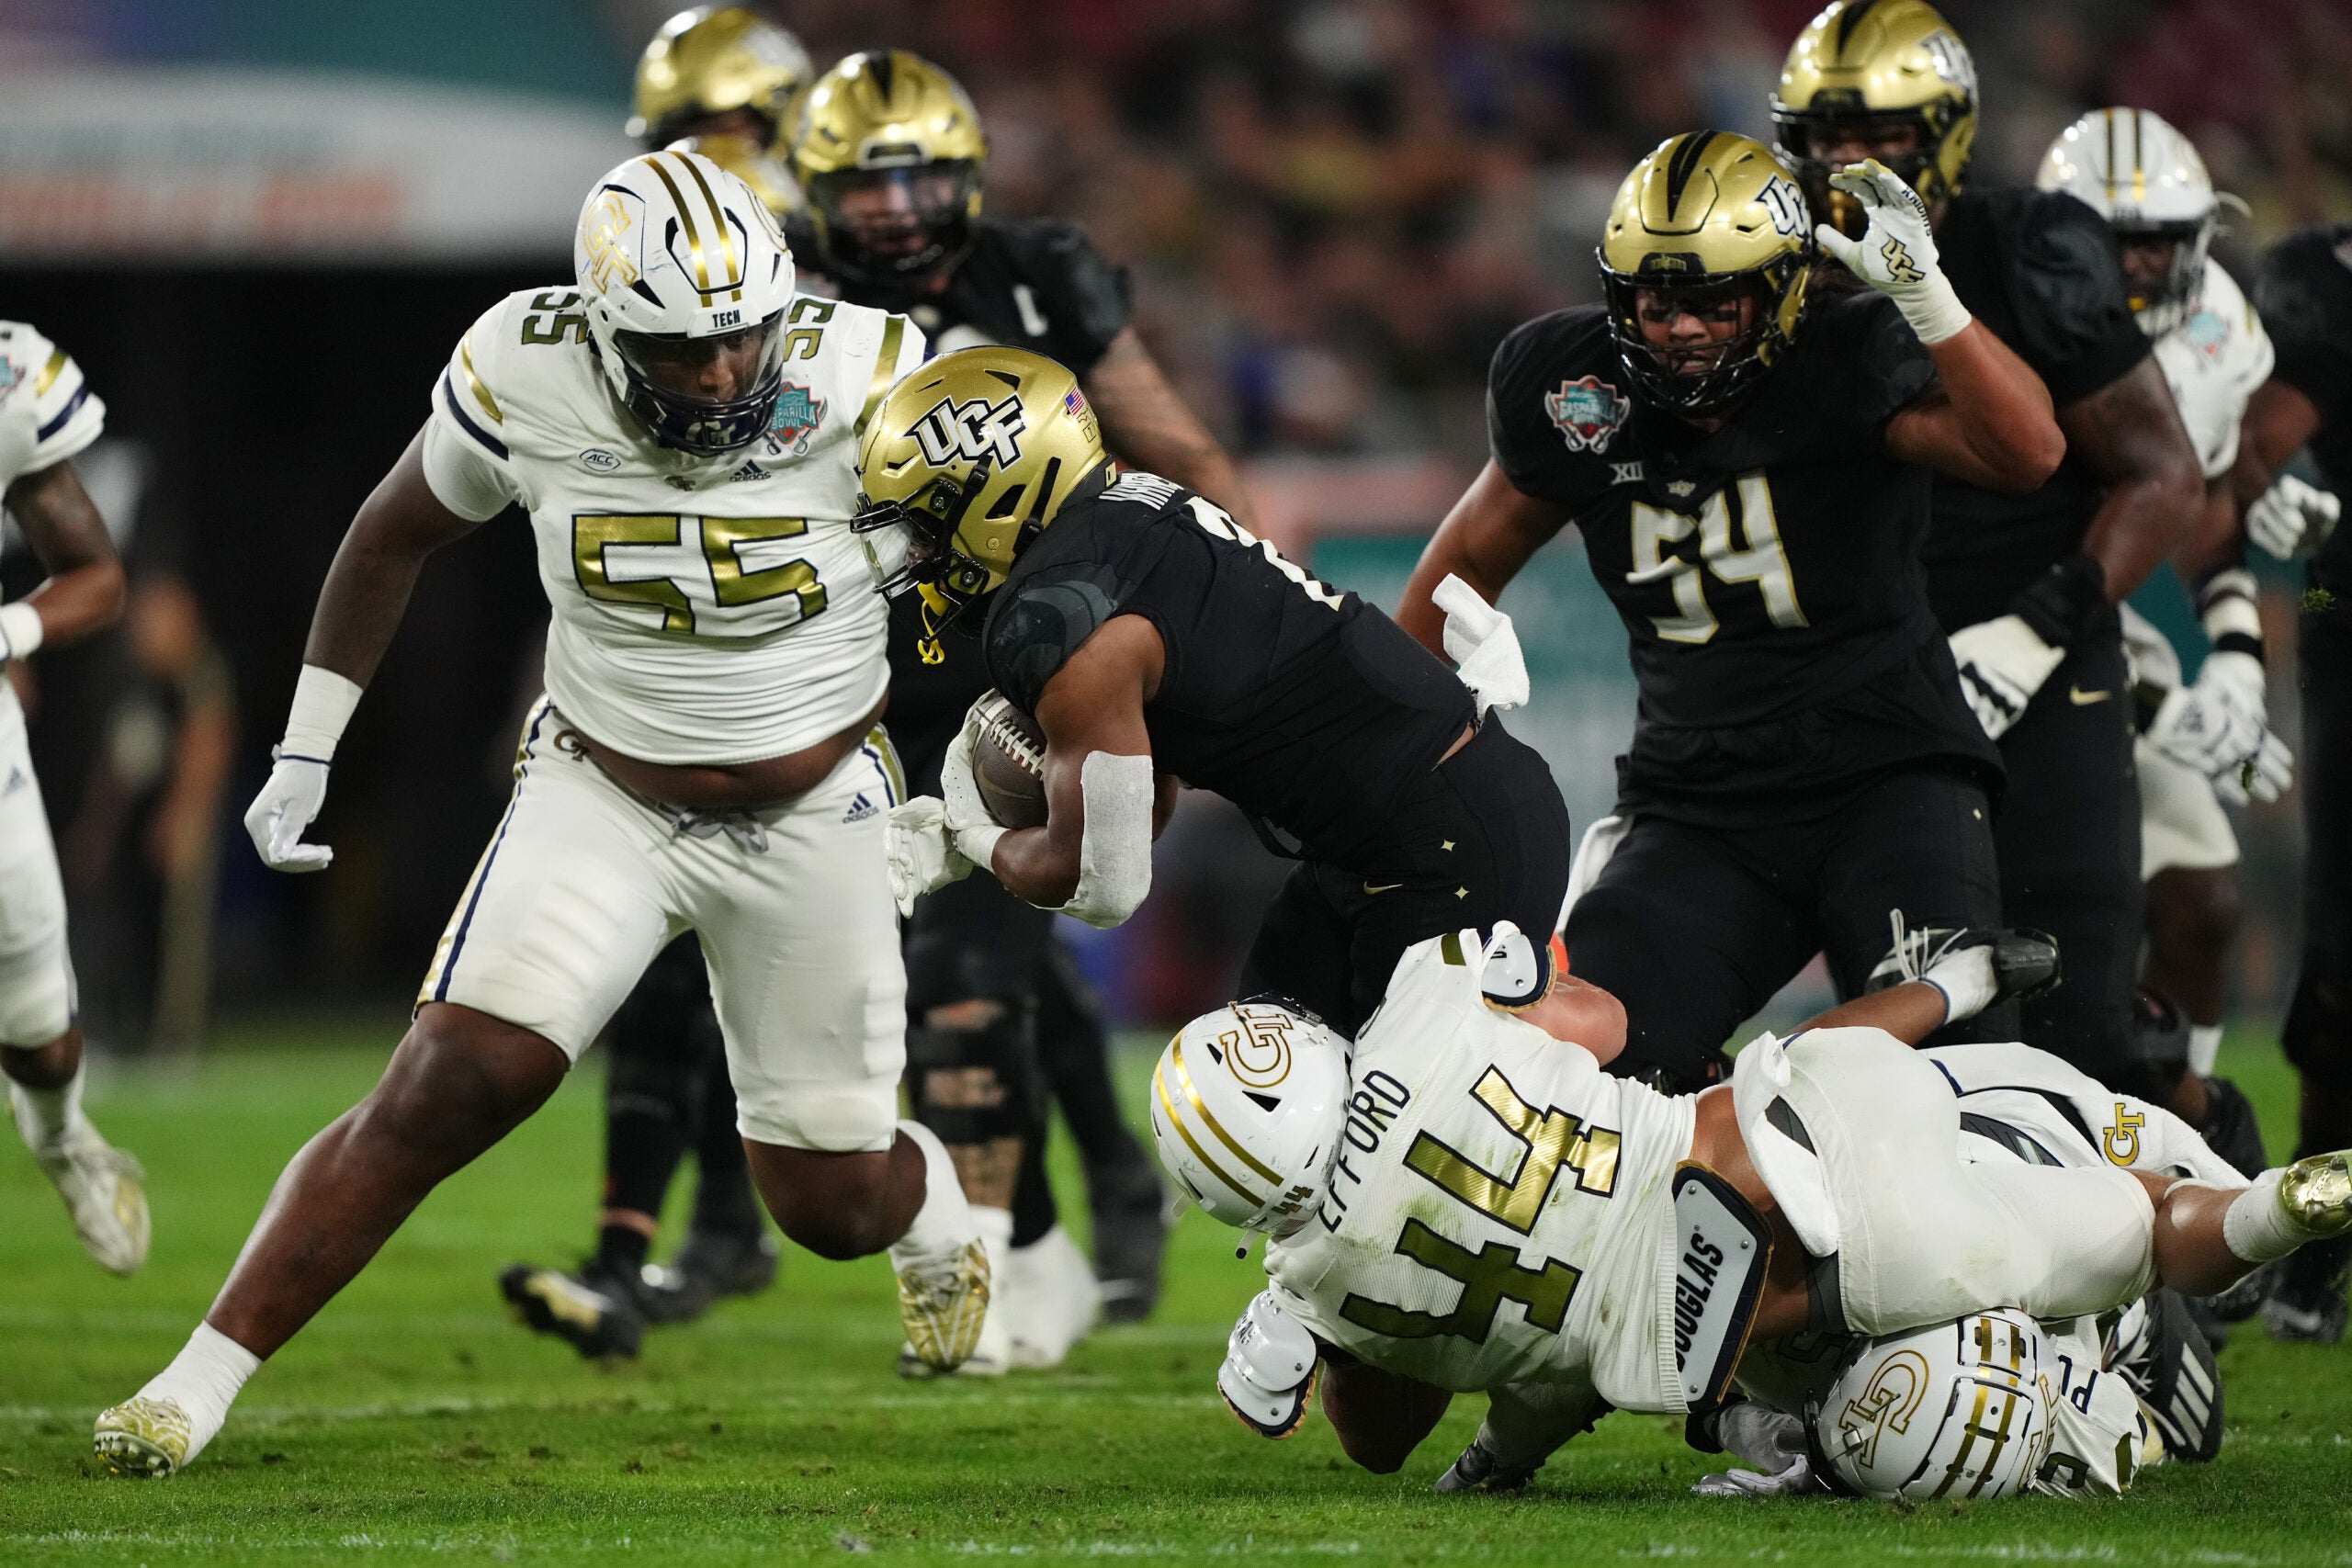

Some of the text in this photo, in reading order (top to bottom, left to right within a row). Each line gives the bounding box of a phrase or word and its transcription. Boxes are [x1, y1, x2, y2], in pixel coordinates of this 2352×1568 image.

[711, 309, 741, 330] TECH
[903, 394, 1027, 472] UCF
[729, 469, 772, 483] adidas
[1608, 461, 1645, 486] XII
[572, 513, 829, 635] 55
[1625, 472, 1811, 645] 54
[842, 806, 880, 824] adidas
[2102, 1102, 2144, 1167] GT
[1271, 1185, 1315, 1216] 44
[1339, 1064, 1622, 1346] 44
